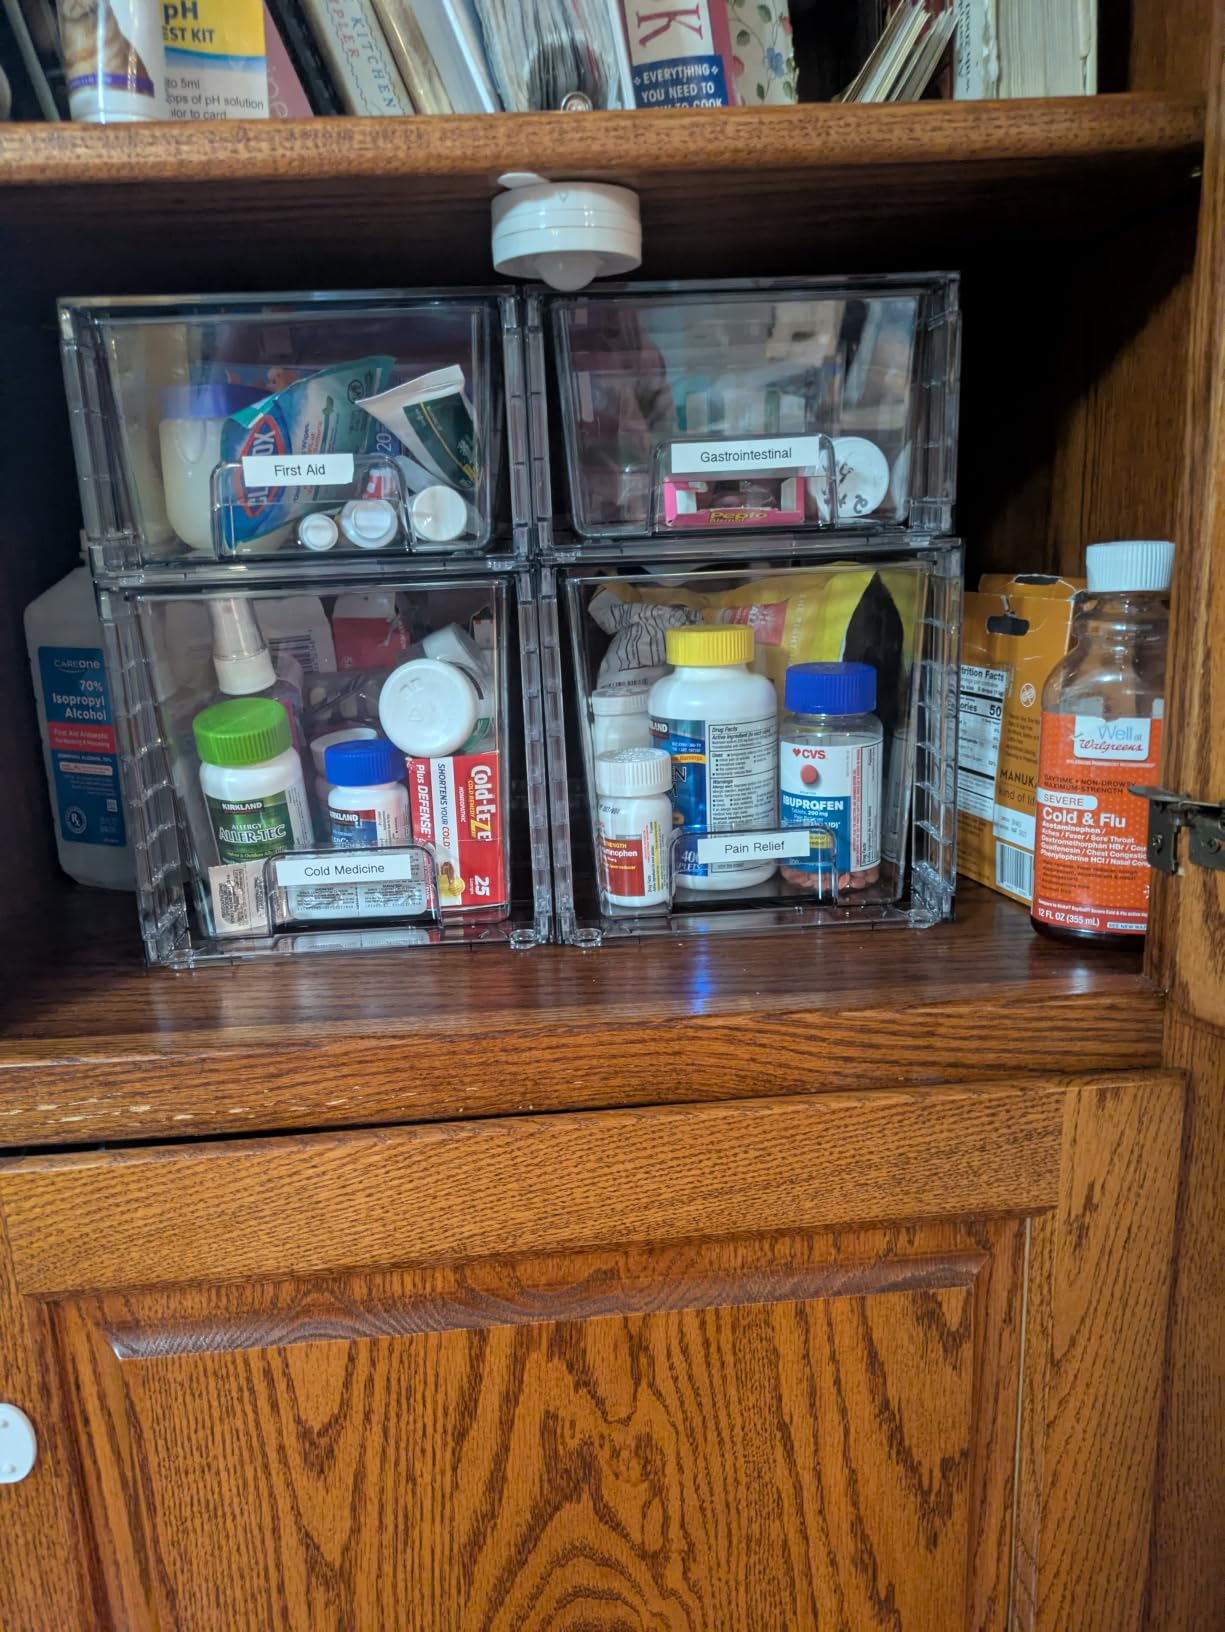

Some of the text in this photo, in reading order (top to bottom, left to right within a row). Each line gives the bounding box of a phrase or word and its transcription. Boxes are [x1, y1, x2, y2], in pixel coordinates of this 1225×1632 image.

[163, 26, 217, 43] EST KIT
[643, 63, 710, 85] EVERYTHING
[641, 81, 715, 104] YOU NEED TO
[223, 96, 264, 111] solution
[376, 433, 391, 452] 20
[700, 446, 793, 463] Gastrointestinal
[274, 463, 326, 478] First Aid
[961, 667, 983, 679] trition
[80, 680, 104, 692] 70%
[52, 692, 106, 708] Isopropyl
[65, 707, 107, 721] Alcohol
[960, 703, 1002, 718] ories 50
[1098, 725, 1133, 741] Well
[1080, 738, 1144, 754] Walgreens
[802, 749, 827, 760] CVS
[1000, 768, 1037, 788] MANUK
[221, 802, 263, 811] KIRKLAND
[416, 763, 431, 836] Plus DEFENSE
[437, 762, 451, 848] SHORTENS YOUR COLD
[783, 795, 844, 811] IBUPROFEN
[1043, 793, 1085, 807] SEVERE
[1042, 806, 1127, 829] Cold & Flu
[1042, 820, 1101, 835] Acetaminophen
[724, 840, 785, 855] Pain Relief
[304, 864, 385, 877] Cold Medicine
[474, 874, 491, 897] 25
[1038, 908, 1045, 917] 12
[1046, 909, 1054, 919] FL
[1055, 912, 1065, 922] OZ
[1066, 913, 1084, 925] (355
